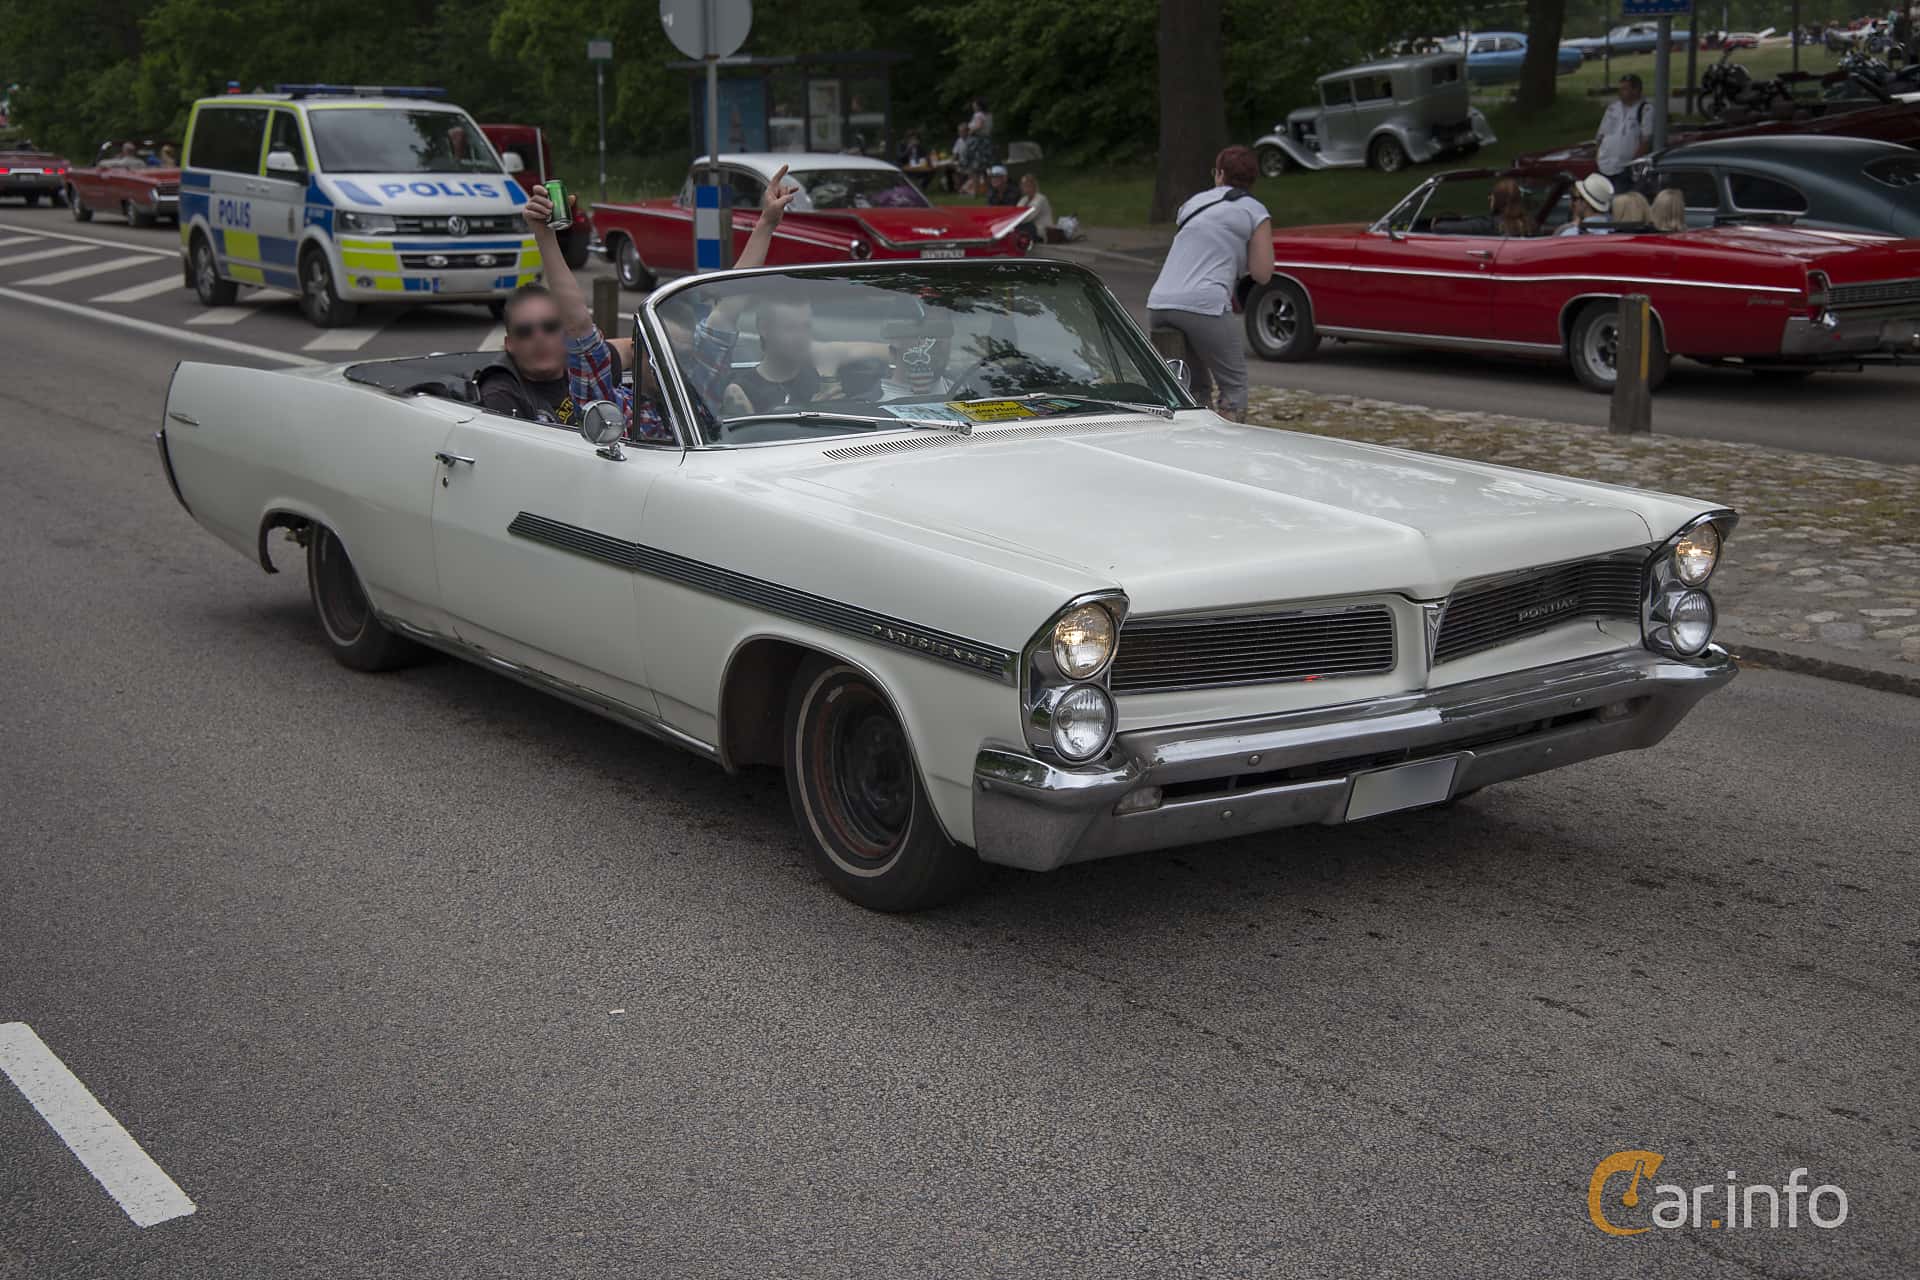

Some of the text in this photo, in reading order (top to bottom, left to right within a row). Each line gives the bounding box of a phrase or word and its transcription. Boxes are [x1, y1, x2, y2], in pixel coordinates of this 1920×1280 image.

[379, 181, 501, 199] POLIS
[218, 199, 251, 228] POLIS
[1519, 599, 1579, 621] PONTIAC
